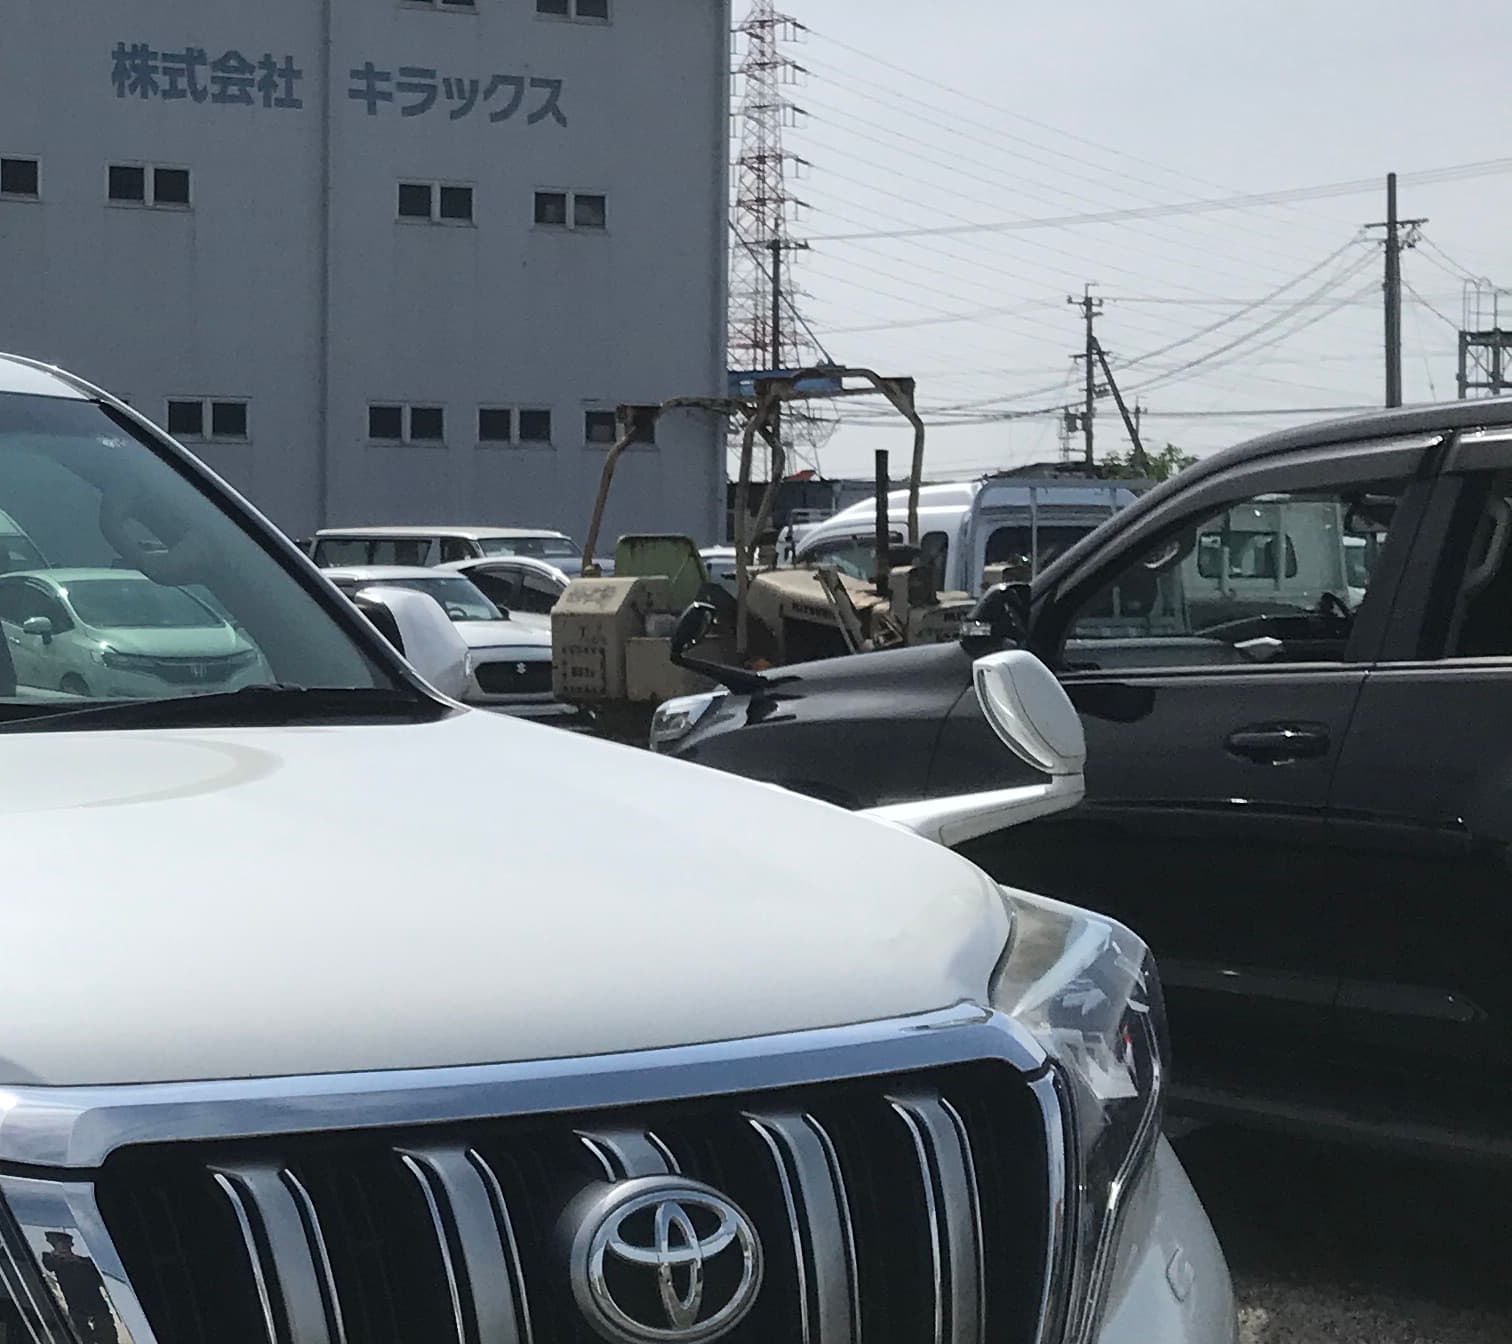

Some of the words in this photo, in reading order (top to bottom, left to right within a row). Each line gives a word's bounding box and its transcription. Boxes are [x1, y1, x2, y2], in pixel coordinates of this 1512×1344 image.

[111, 42, 303, 109] 株式会社
[348, 61, 568, 128] キラックス
